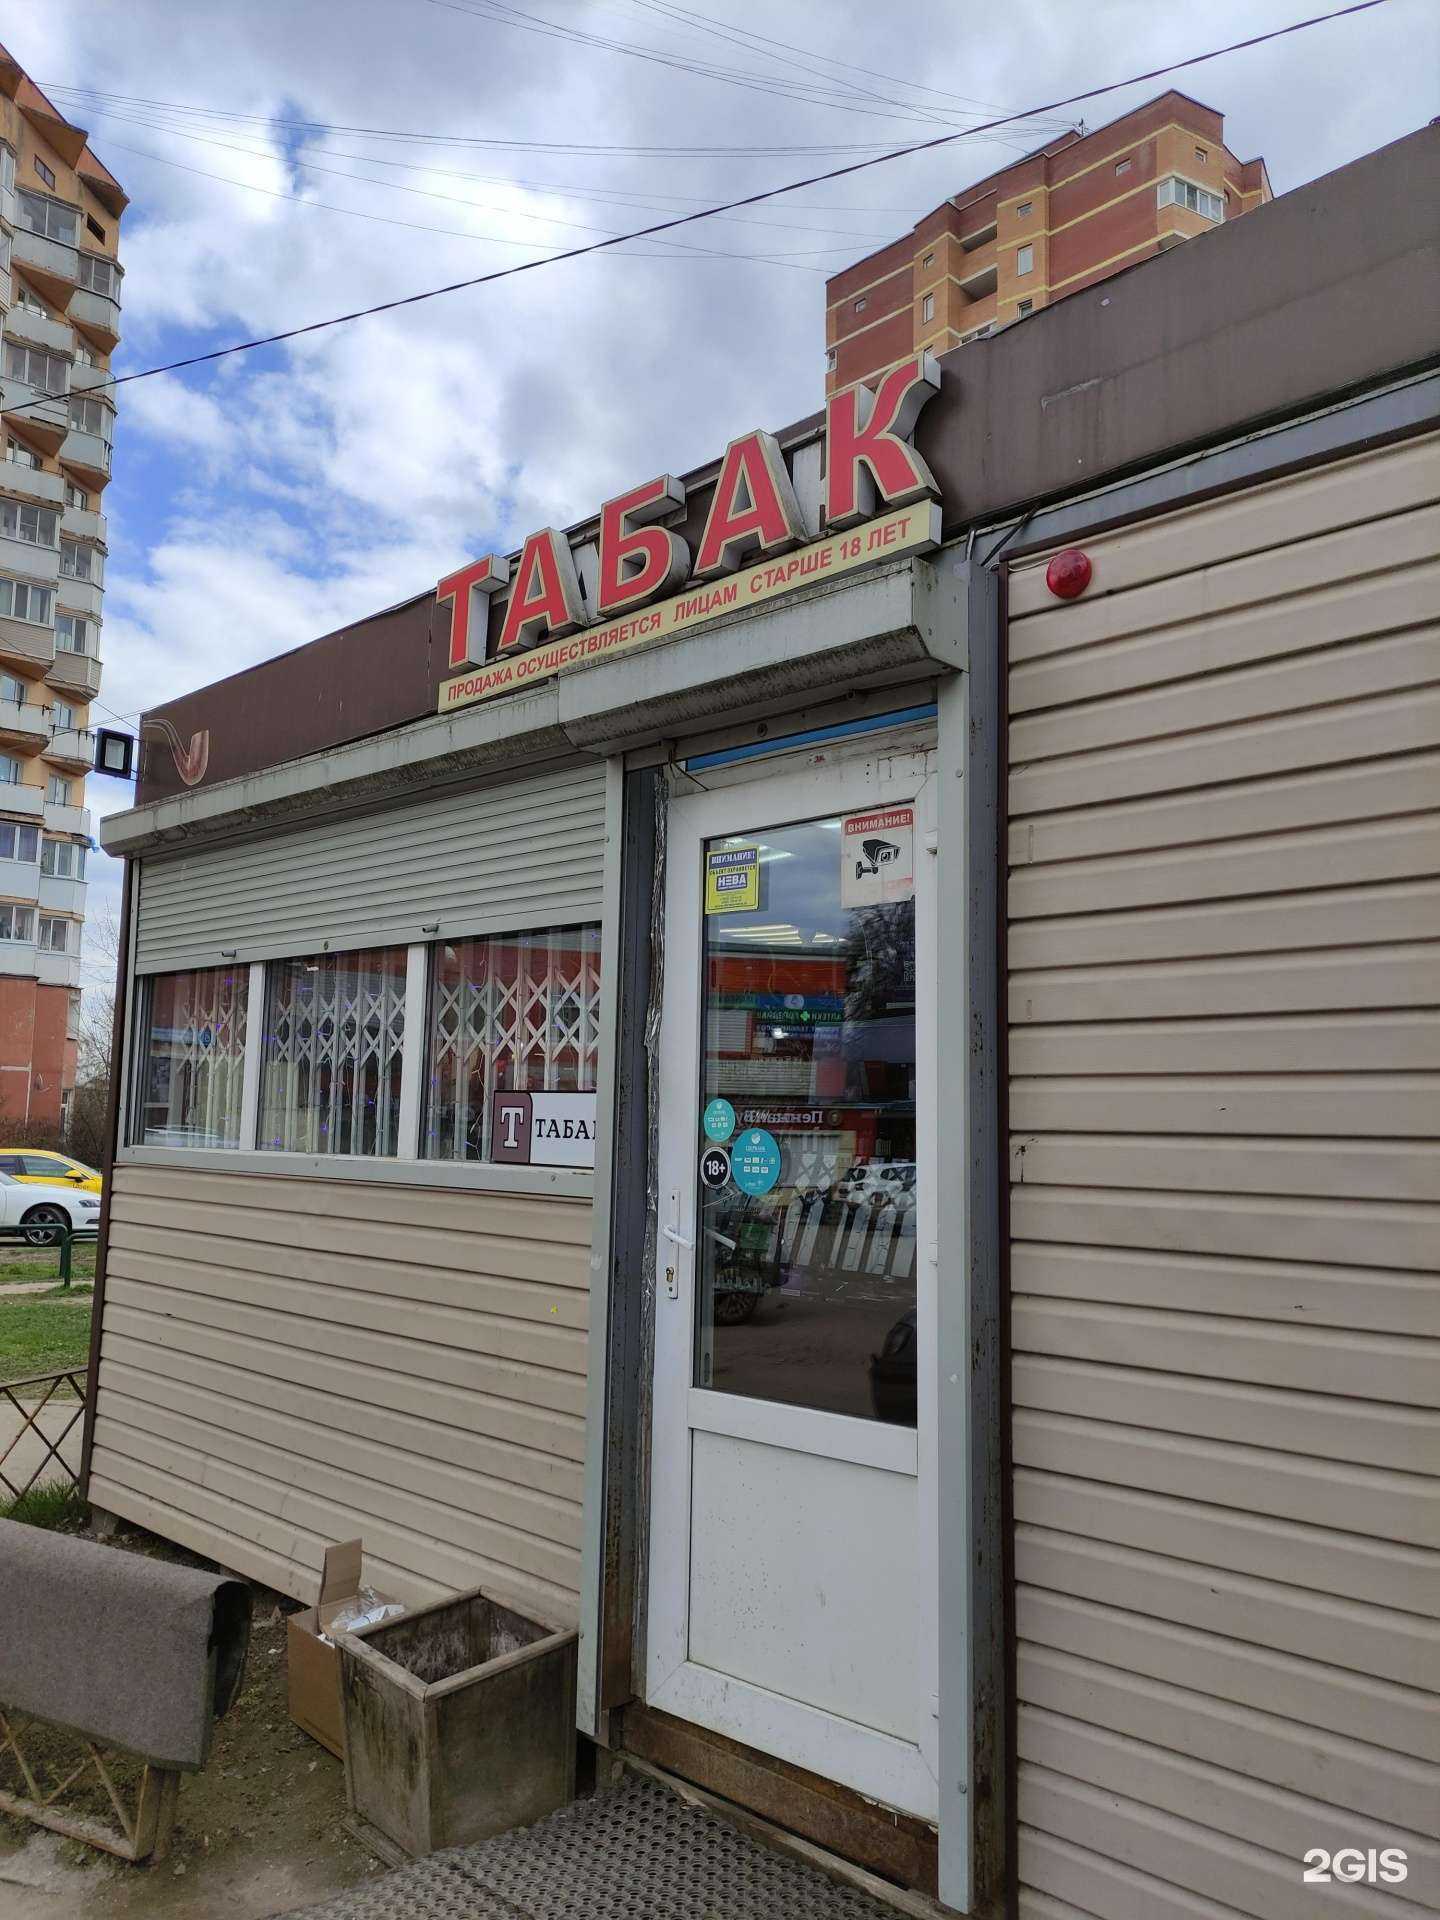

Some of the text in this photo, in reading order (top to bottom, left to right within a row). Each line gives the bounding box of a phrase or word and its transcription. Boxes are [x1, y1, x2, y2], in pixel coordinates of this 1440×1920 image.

[437, 351, 941, 669] ТАБАК
[447, 517, 912, 702] ПРОДАЖА ОСУЩЕСТВЛЯЕТСЯ ЛИЦАМ СТАРШЕ 18 ЛЕТ
[847, 813, 910, 833] ВНИМАНИЕ!
[718, 873, 746, 887] НЕВА
[501, 1106, 524, 1148] Т
[706, 1160, 726, 1176] 18+
